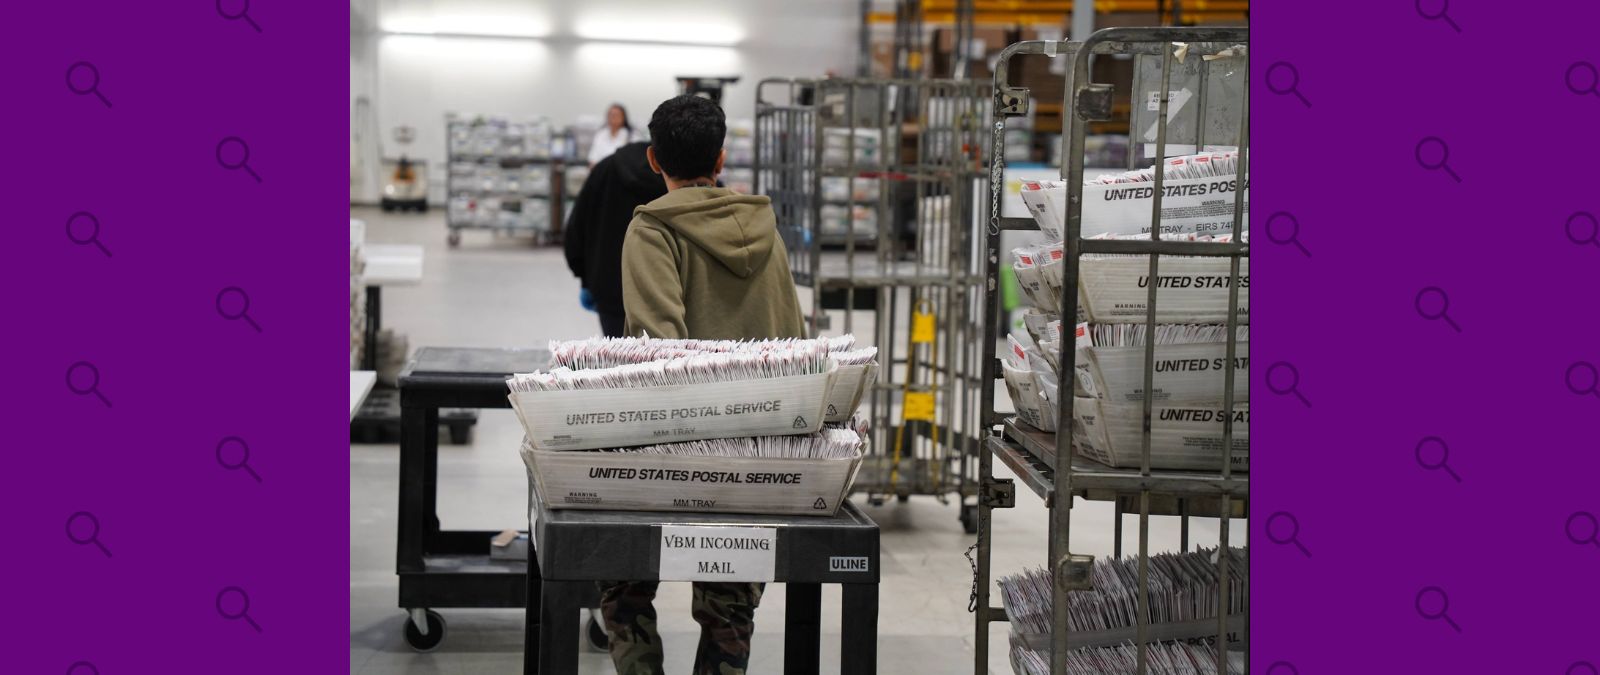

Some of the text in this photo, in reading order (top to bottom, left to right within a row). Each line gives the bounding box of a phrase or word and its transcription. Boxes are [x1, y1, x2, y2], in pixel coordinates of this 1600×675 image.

[1104, 180, 1249, 200] UNITED STATES POSA
[1196, 223, 1218, 231] EIRS
[1138, 276, 1191, 288] UITED
[1155, 357, 1249, 372] UNITED SAT
[566, 400, 781, 425] UNITED STATES POSTAL SERVICE
[1160, 408, 1213, 422] UNITED
[672, 427, 696, 436] TRAY
[589, 467, 802, 484] UNITED STATES POSTAL SERVICE
[673, 498, 716, 508] MM TRAY
[664, 534, 770, 551] VBM INCOMING
[697, 561, 735, 574] MAIL
[832, 559, 866, 569] ULINE
